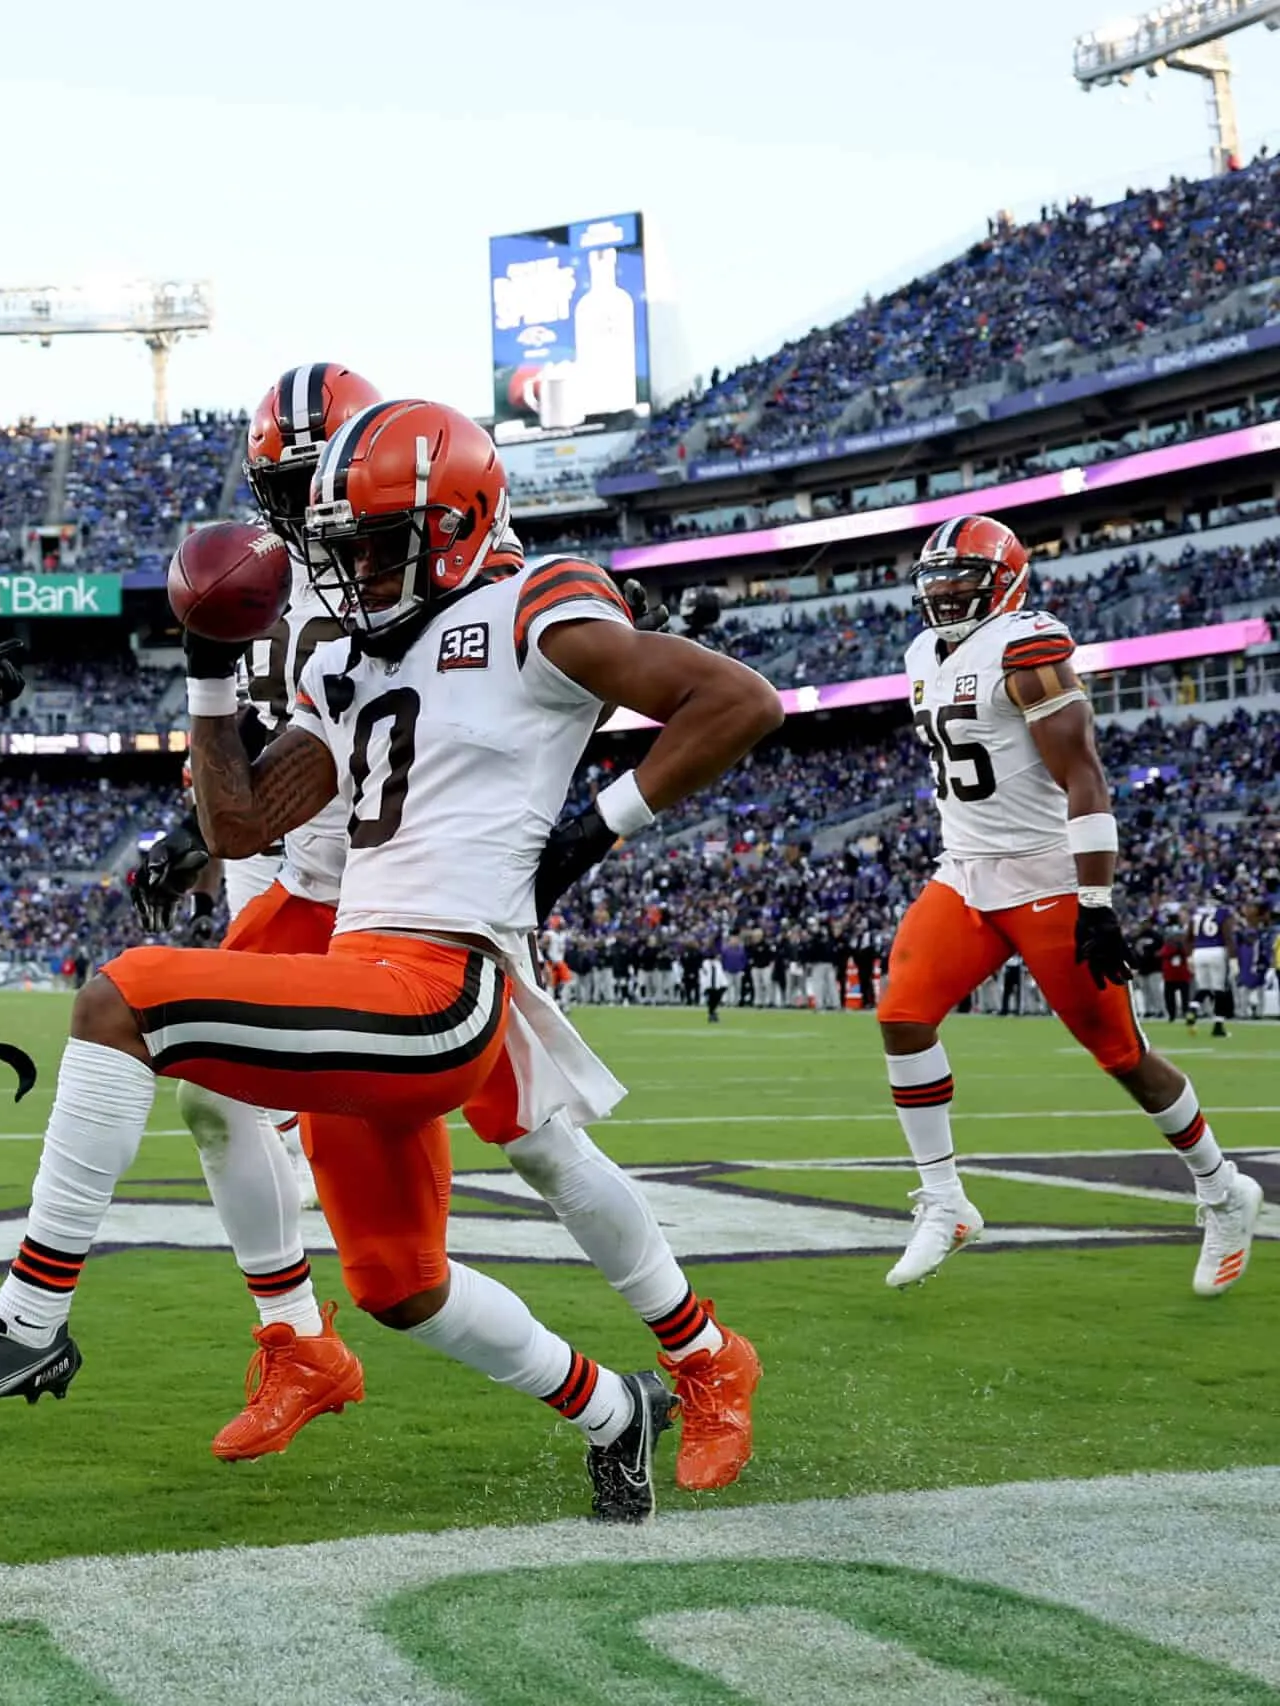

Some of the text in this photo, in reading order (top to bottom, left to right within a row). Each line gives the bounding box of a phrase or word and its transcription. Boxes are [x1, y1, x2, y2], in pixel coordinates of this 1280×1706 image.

[12, 576, 100, 613] Bank
[441, 626, 485, 660] 32
[955, 675, 977, 697] 32
[347, 686, 421, 849] 0
[1192, 906, 1219, 937] 76
